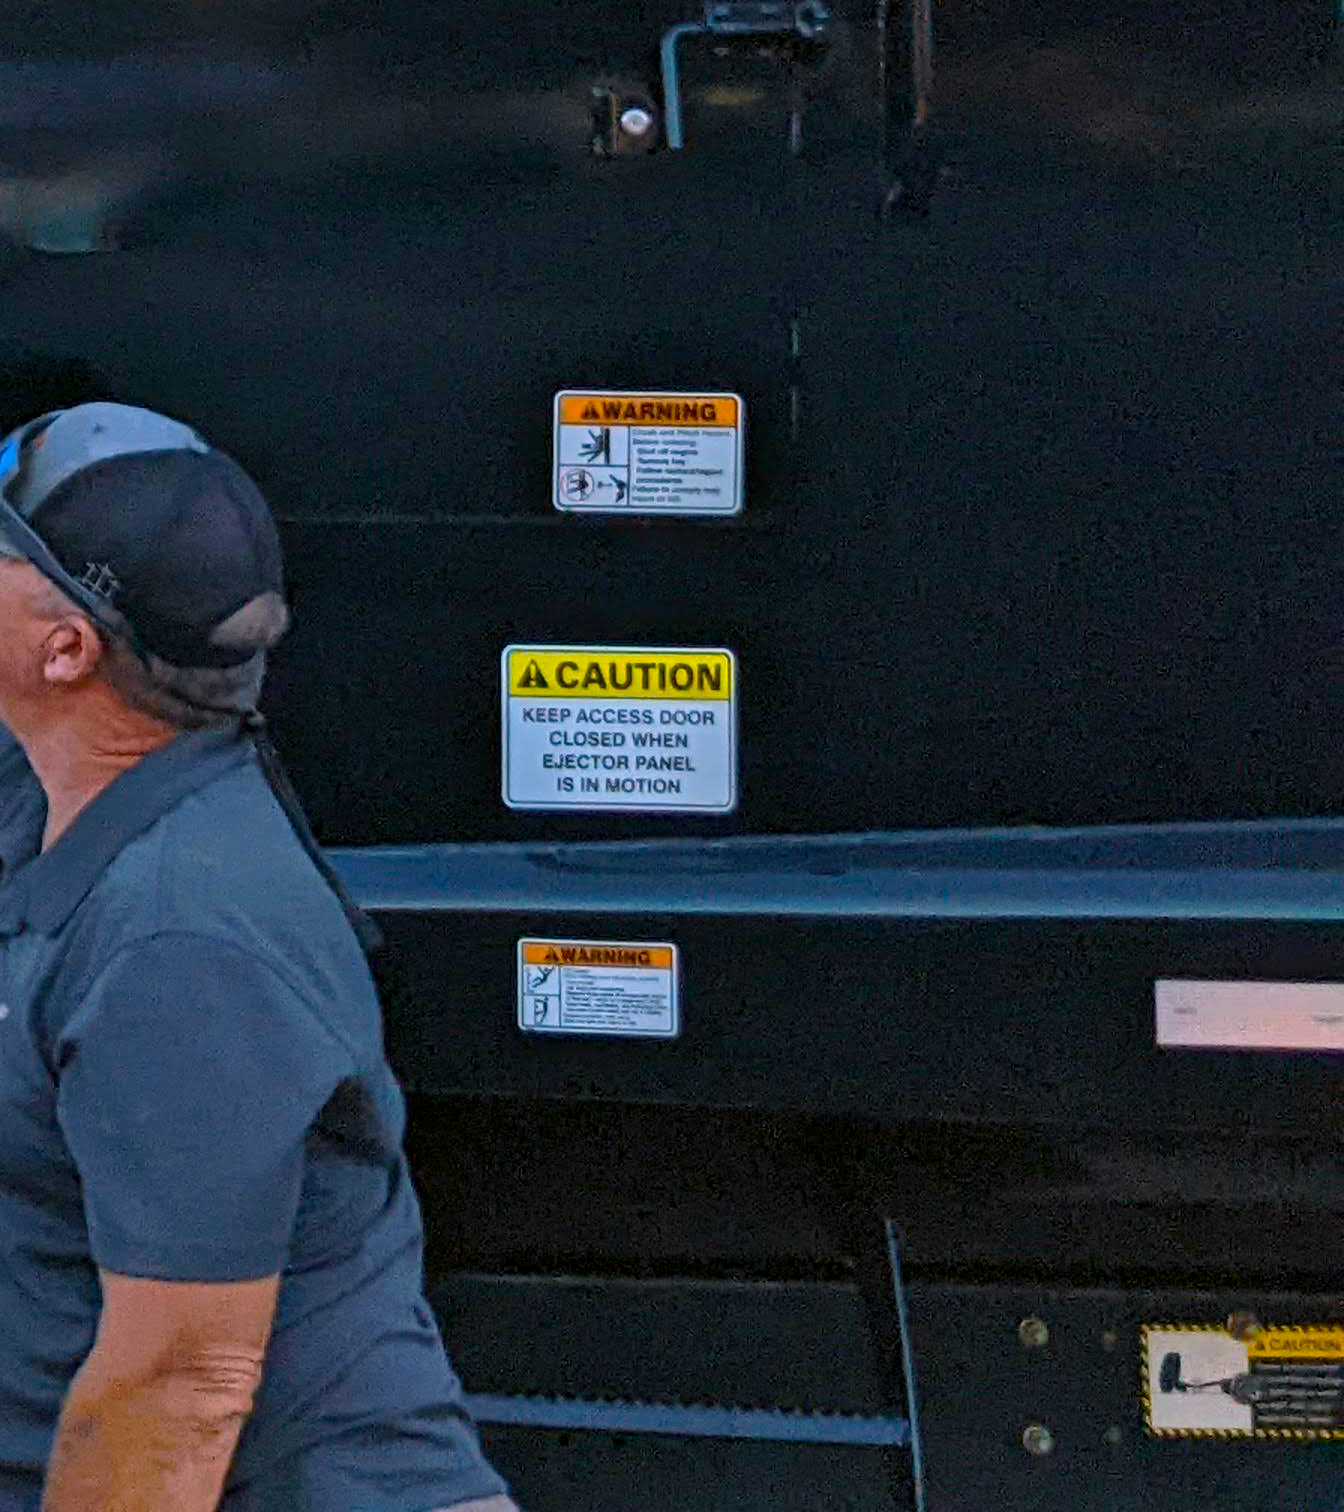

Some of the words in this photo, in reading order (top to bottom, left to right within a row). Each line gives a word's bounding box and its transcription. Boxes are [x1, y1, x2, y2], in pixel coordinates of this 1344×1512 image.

[602, 400, 717, 422] WARNING
[555, 660, 722, 691] CAUTION
[522, 707, 572, 723] KEEP
[576, 708, 654, 725] ACCESS
[660, 710, 715, 726] DOOR
[549, 731, 626, 747] CLOSED
[631, 732, 689, 748] WHEN
[542, 753, 629, 770] EJECTOR
[635, 755, 696, 772] PANEL
[556, 777, 574, 793] IS
[580, 777, 599, 793] IN
[605, 777, 681, 794] MOTION
[561, 947, 651, 965] WARNING
